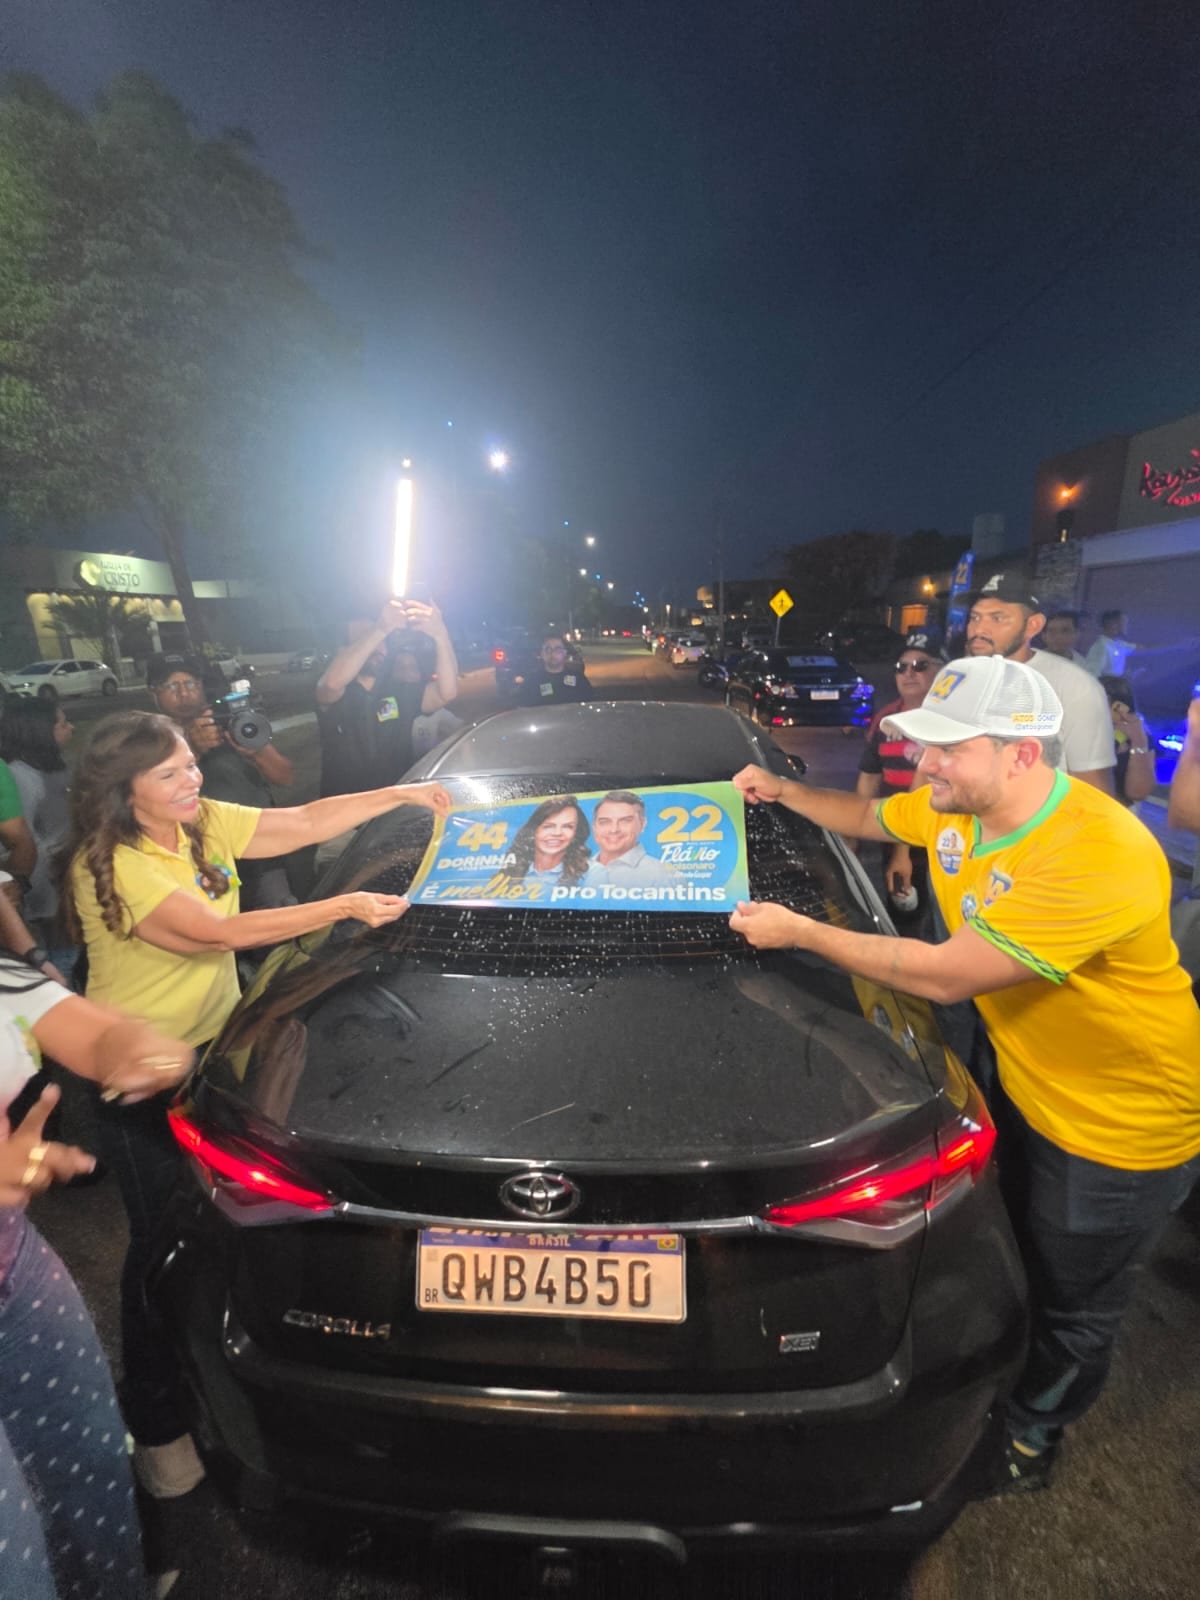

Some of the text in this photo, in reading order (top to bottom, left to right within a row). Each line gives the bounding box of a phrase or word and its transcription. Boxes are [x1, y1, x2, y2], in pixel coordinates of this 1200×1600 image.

[457, 822, 508, 851] 44
[657, 805, 723, 842] 22
[437, 853, 517, 870] DORINHA
[421, 872, 726, 903] É melhor pro Tocantins
[443, 1253, 651, 1307] QWB4B50
[424, 1288, 439, 1303] BR
